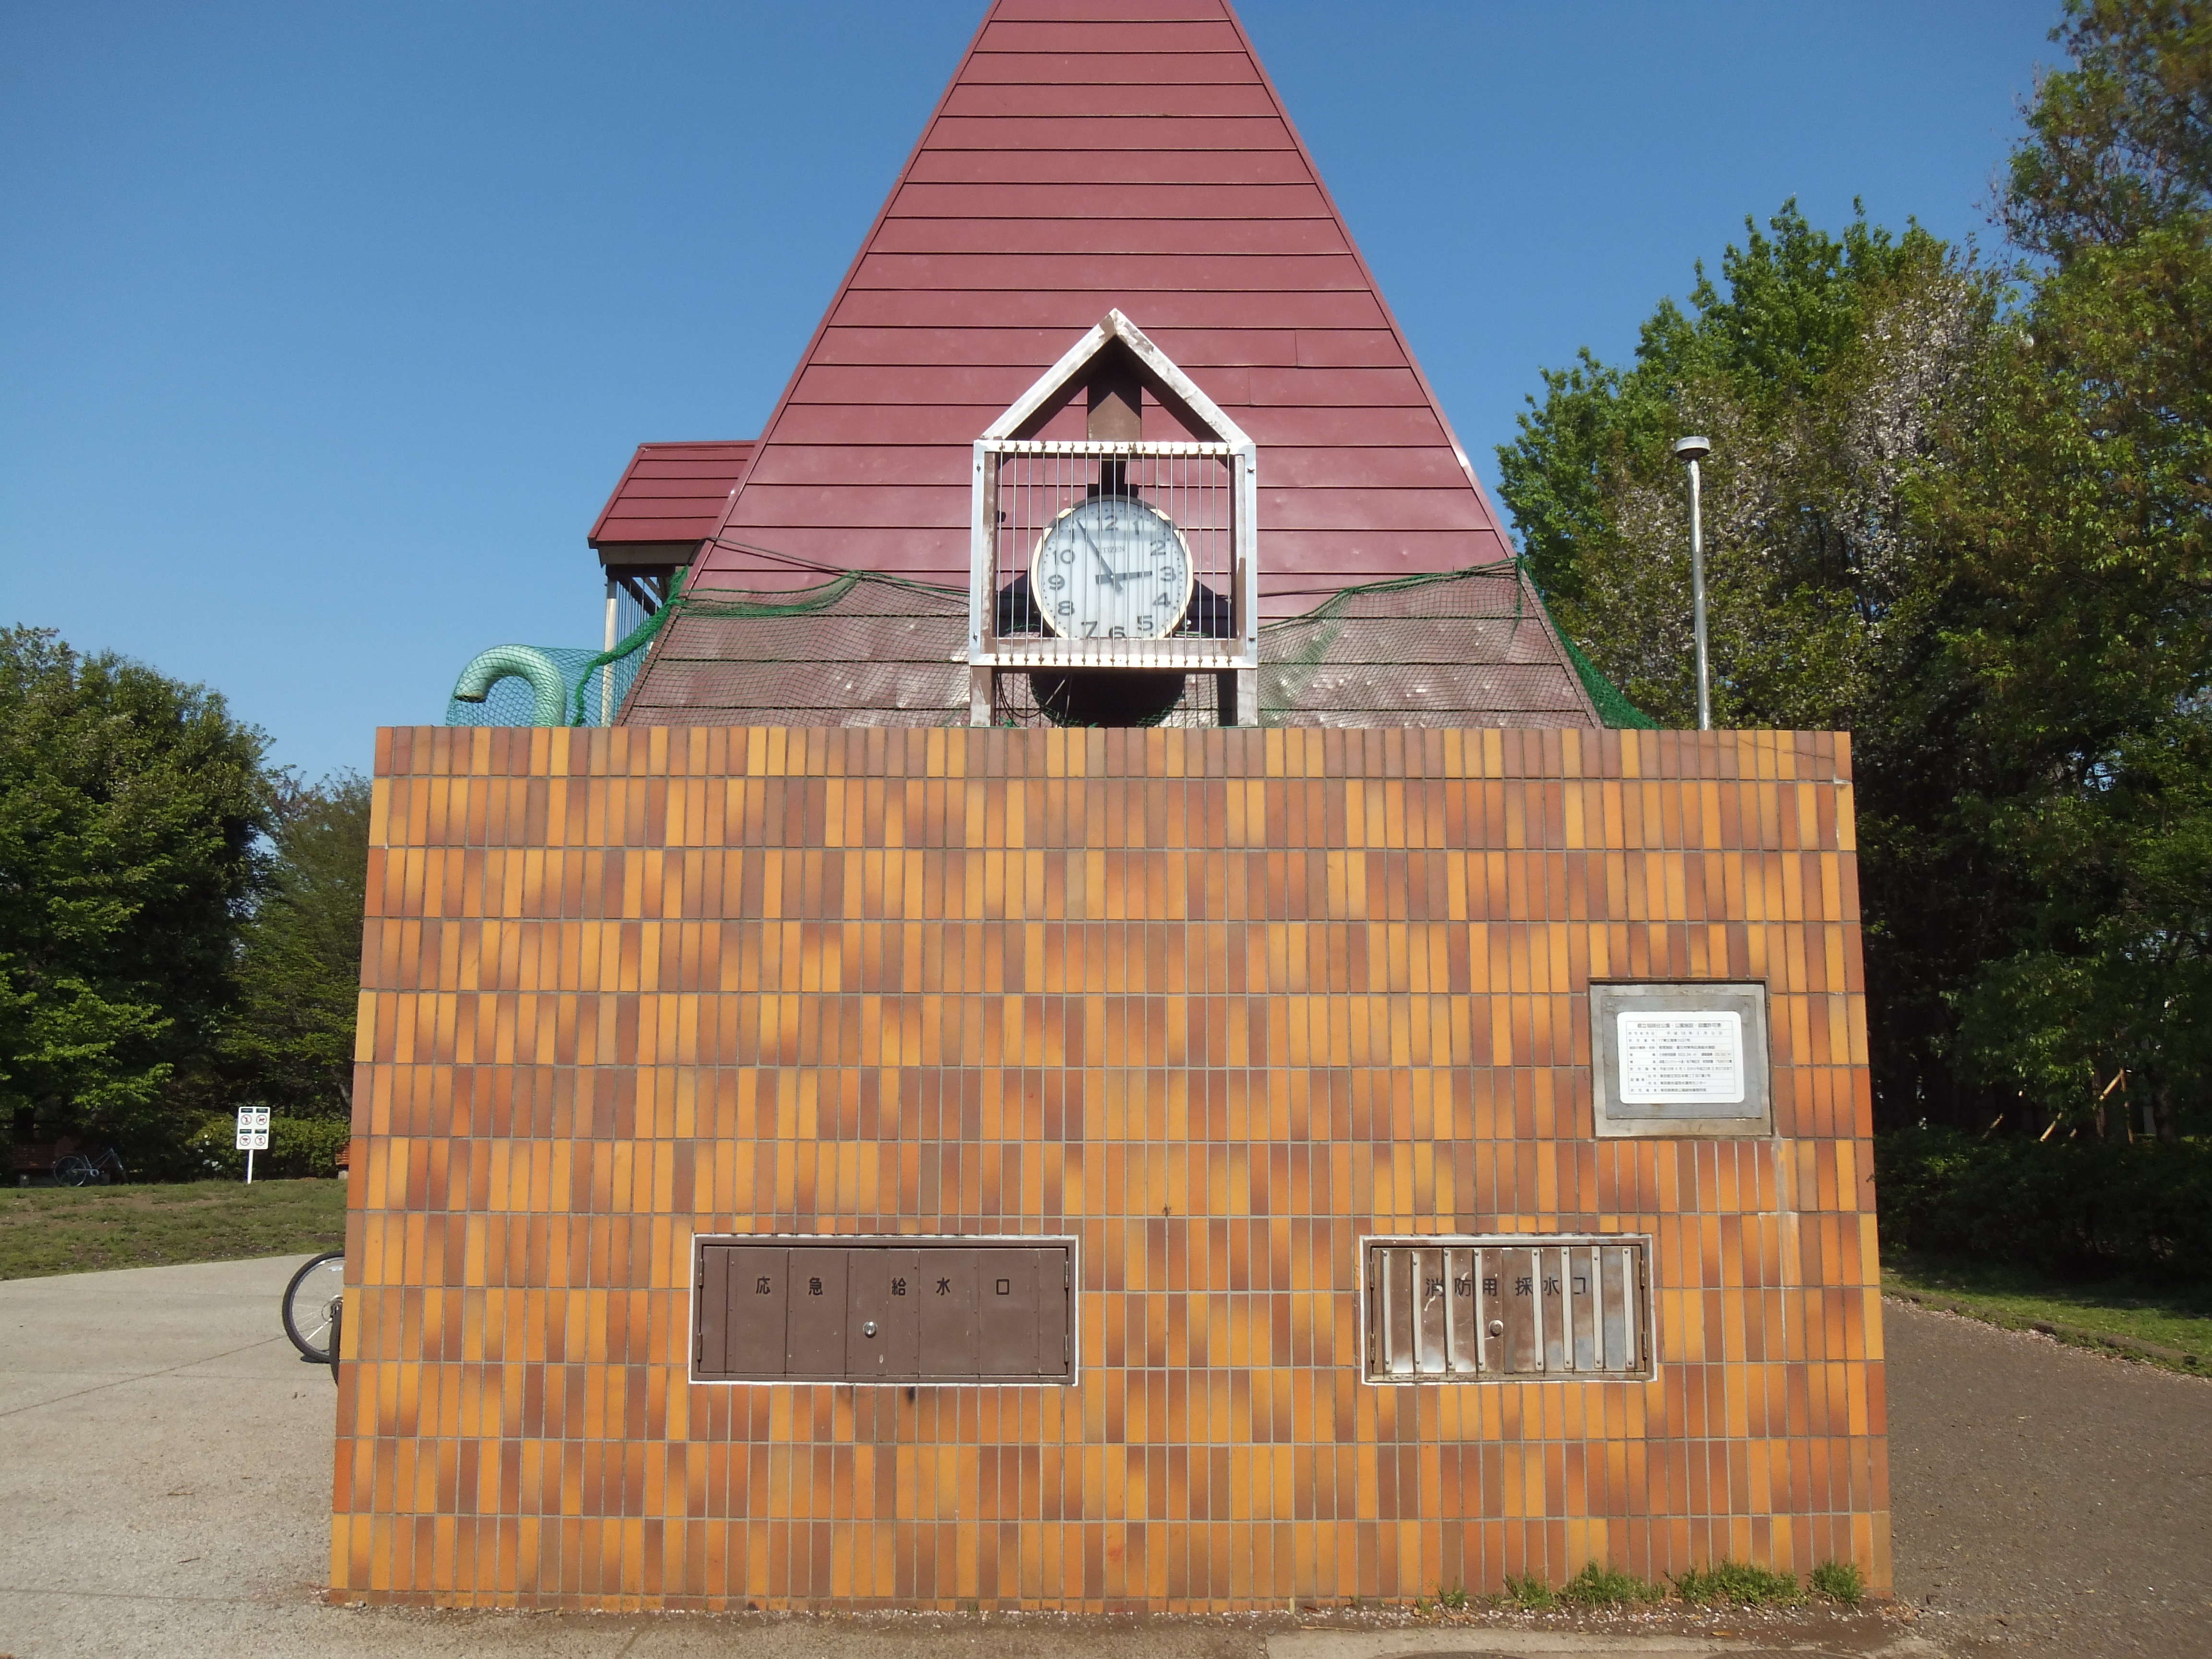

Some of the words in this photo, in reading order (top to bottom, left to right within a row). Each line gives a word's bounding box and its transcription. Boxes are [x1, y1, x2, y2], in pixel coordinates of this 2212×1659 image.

[1133, 521, 1139, 535] 1
[1096, 545, 1125, 553] TIZEN
[1151, 540, 1166, 556] 2
[1053, 549, 1075, 565] 10
[1160, 566, 1176, 581] 3
[1048, 574, 1065, 590] 9
[1153, 592, 1170, 607] 4
[1058, 601, 1075, 616] 8
[1081, 621, 1097, 638] 7
[1137, 615, 1154, 631] 5
[1109, 626, 1126, 638] 6
[756, 1276, 1010, 1297] 応急給水口
